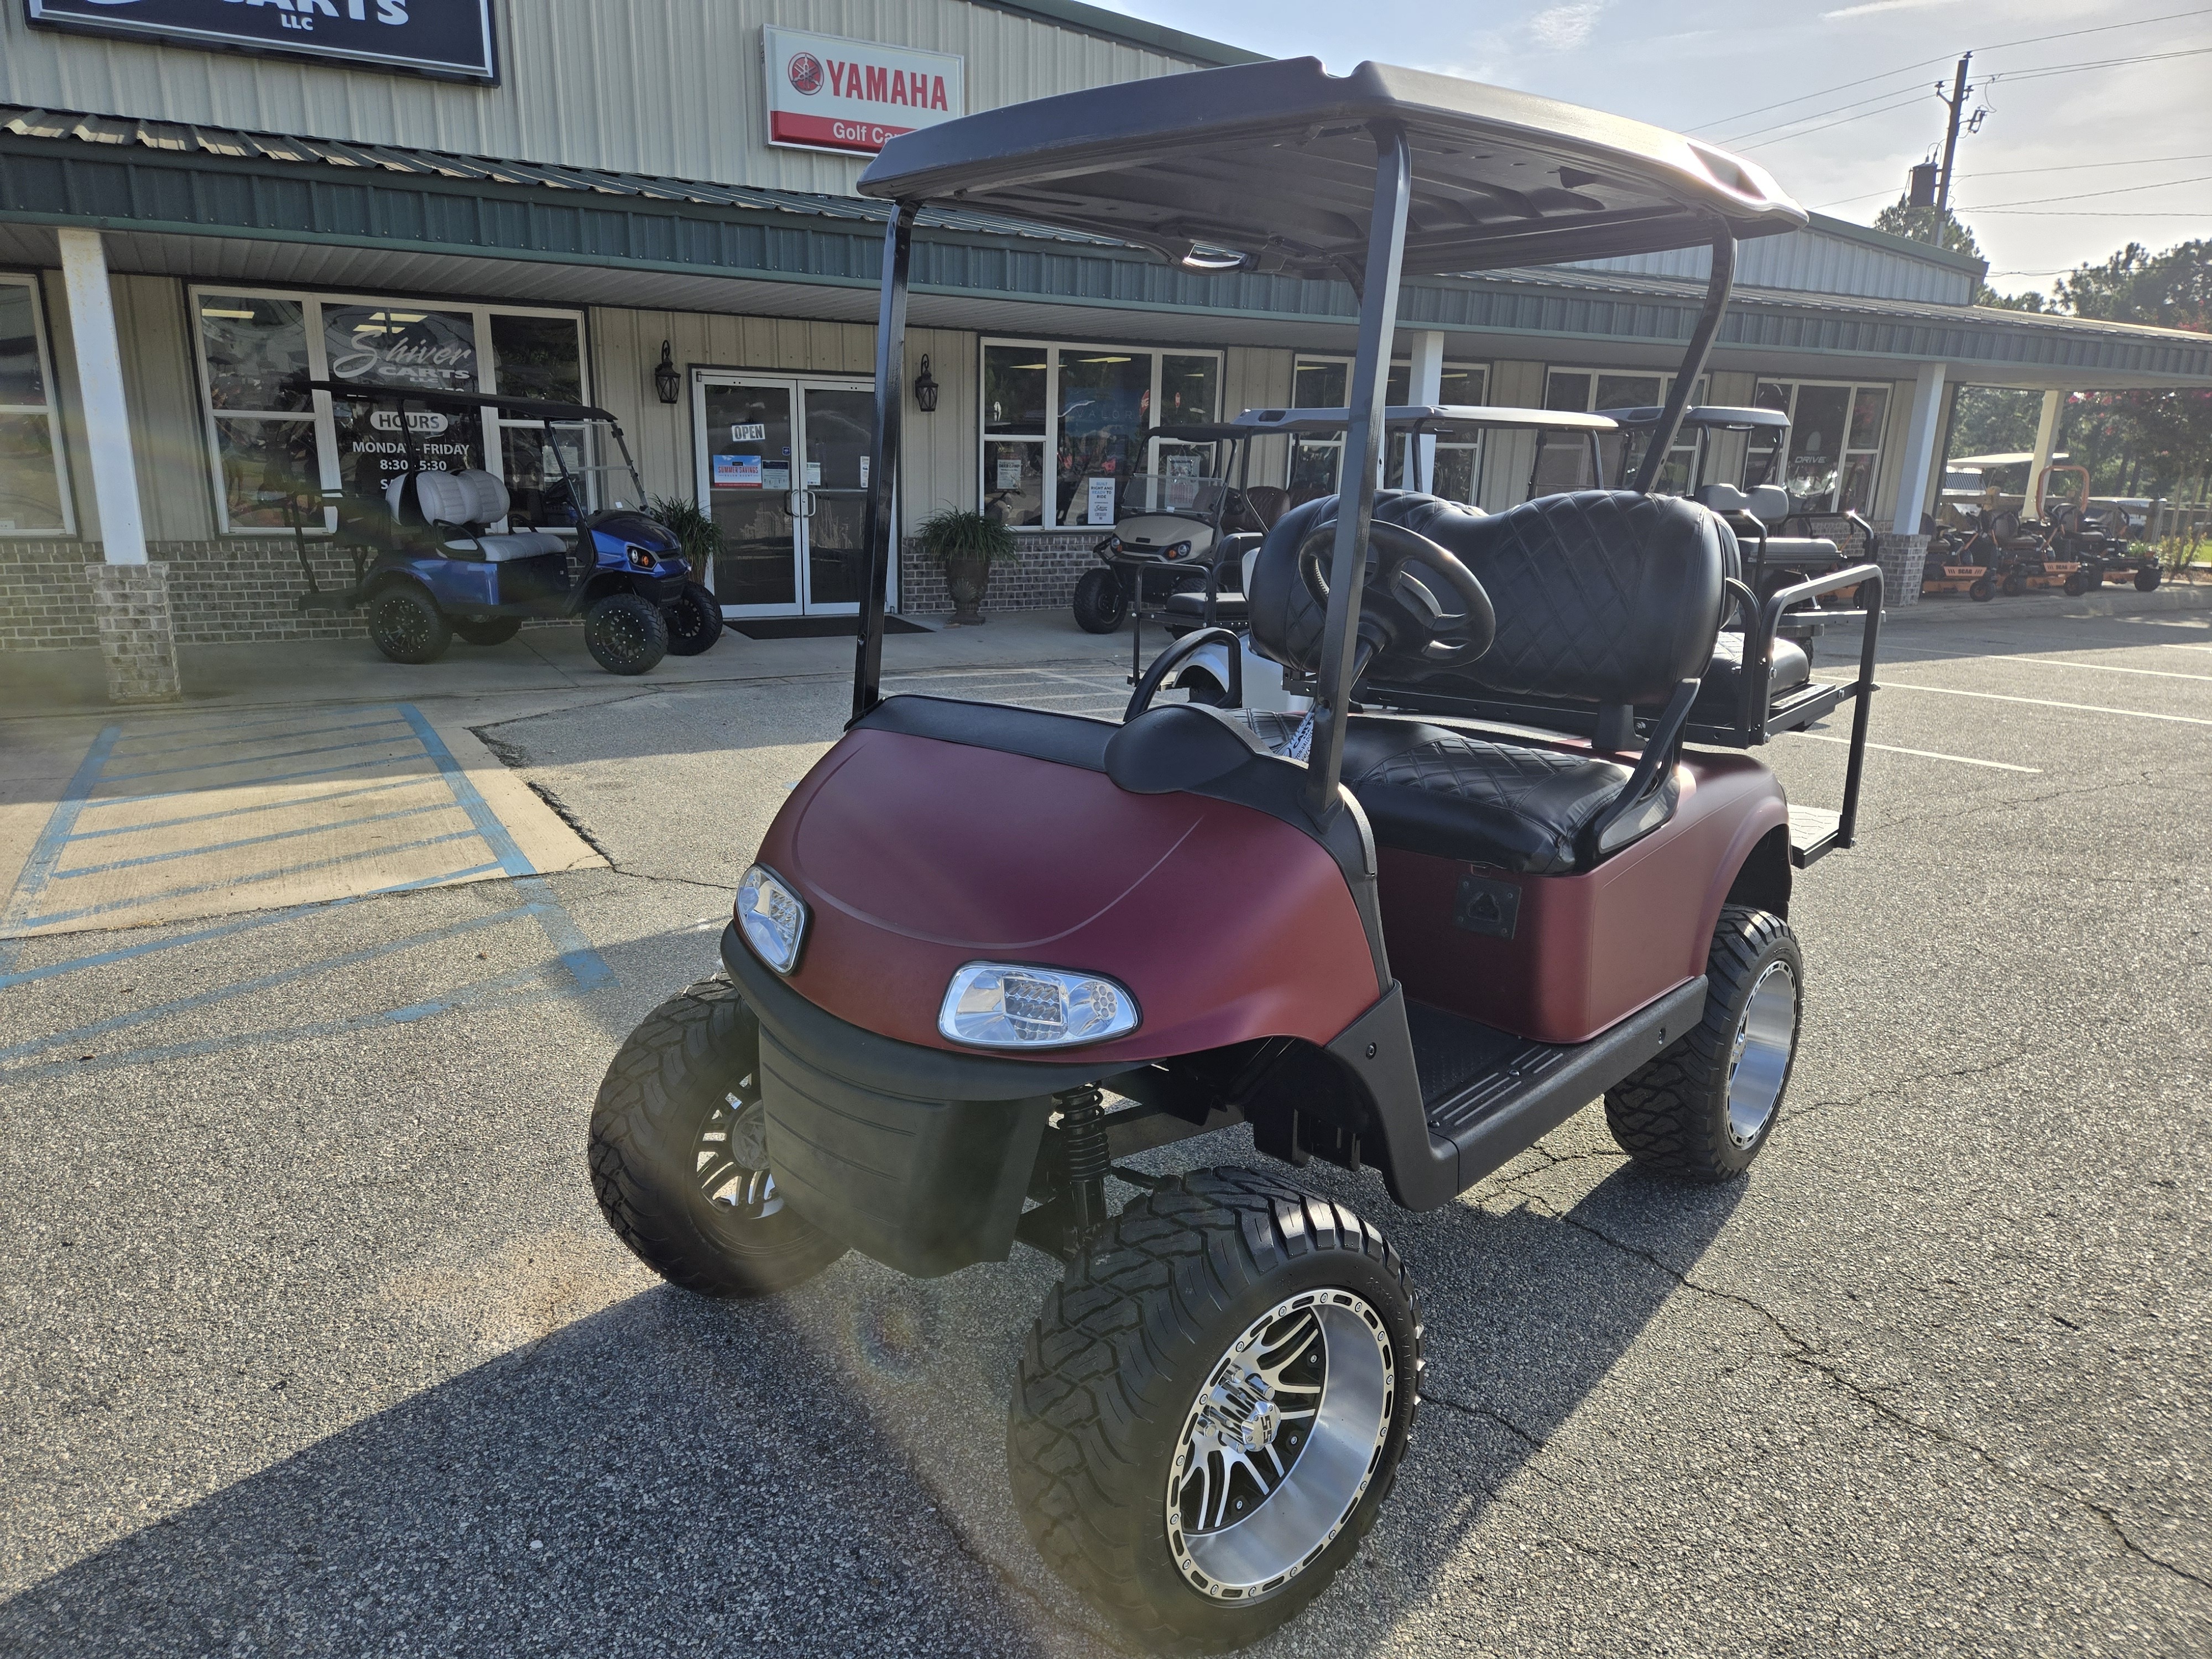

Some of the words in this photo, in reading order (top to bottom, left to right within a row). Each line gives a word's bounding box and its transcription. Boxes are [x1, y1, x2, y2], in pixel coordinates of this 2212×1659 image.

[281, 13, 314, 30] LLC
[826, 59, 948, 112] YAMAHA
[833, 122, 867, 142] Golf
[333, 330, 472, 379] Shiver
[378, 367, 470, 379] CARTS
[379, 414, 440, 430] HOURS
[1077, 410, 1133, 420] VALOR
[734, 425, 763, 440] OPEN
[424, 444, 470, 456] FRIDAY
[380, 460, 409, 471] 8:30
[419, 460, 447, 471] 5:30
